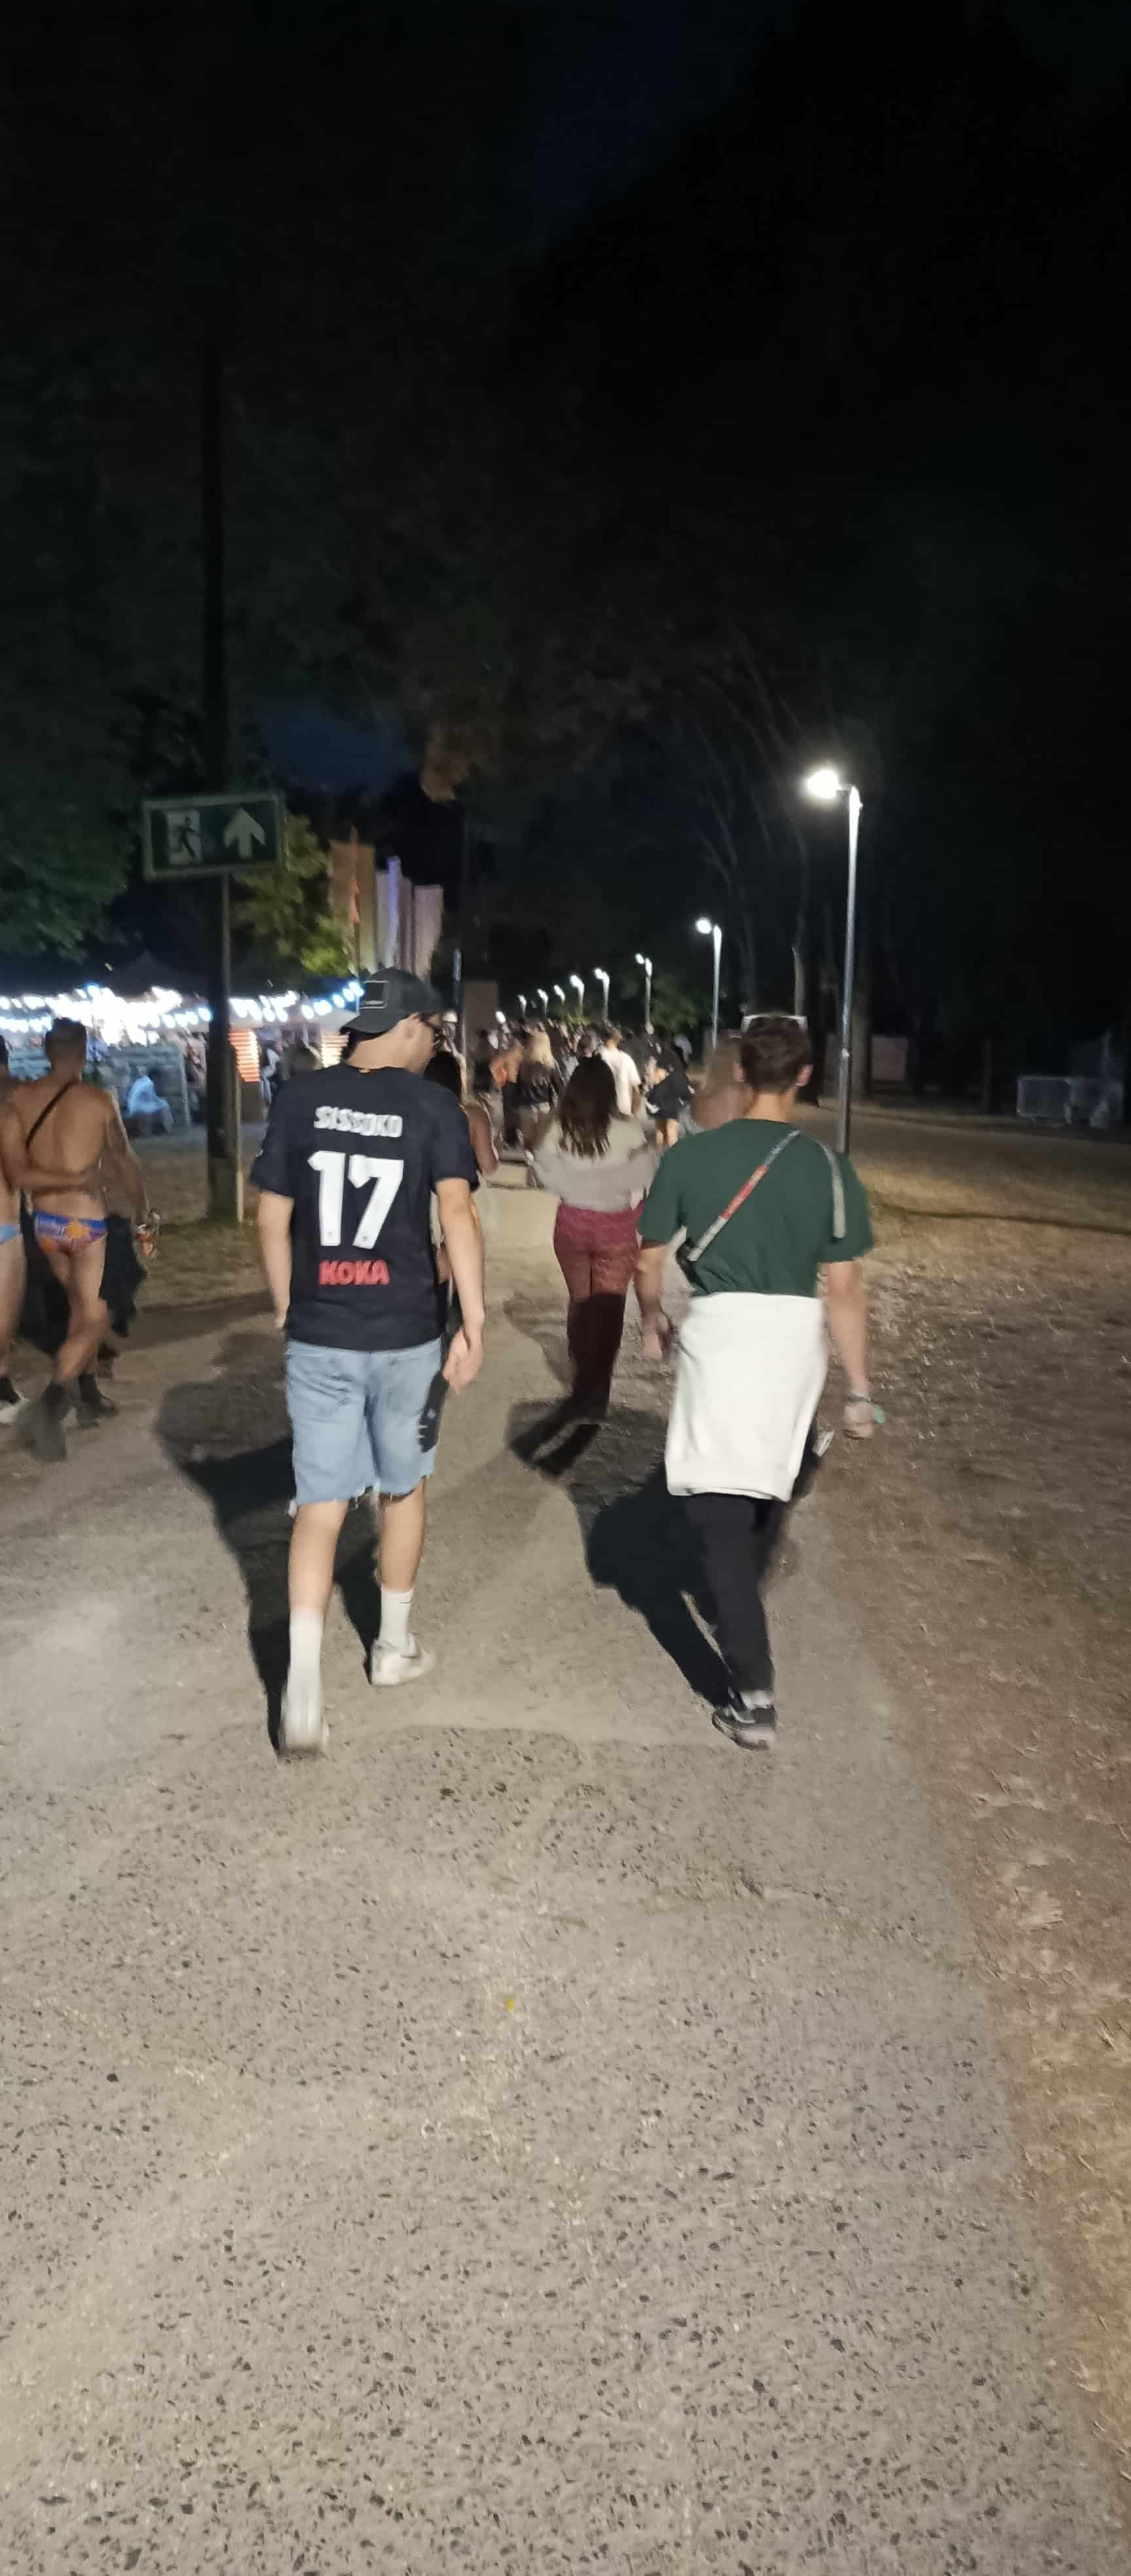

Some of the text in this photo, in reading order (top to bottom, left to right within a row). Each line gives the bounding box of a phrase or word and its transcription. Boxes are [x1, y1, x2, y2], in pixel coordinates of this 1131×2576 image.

[314, 1105, 403, 1137] SISSOKO
[307, 1150, 404, 1249] 17
[319, 1259, 389, 1285] KOKA
